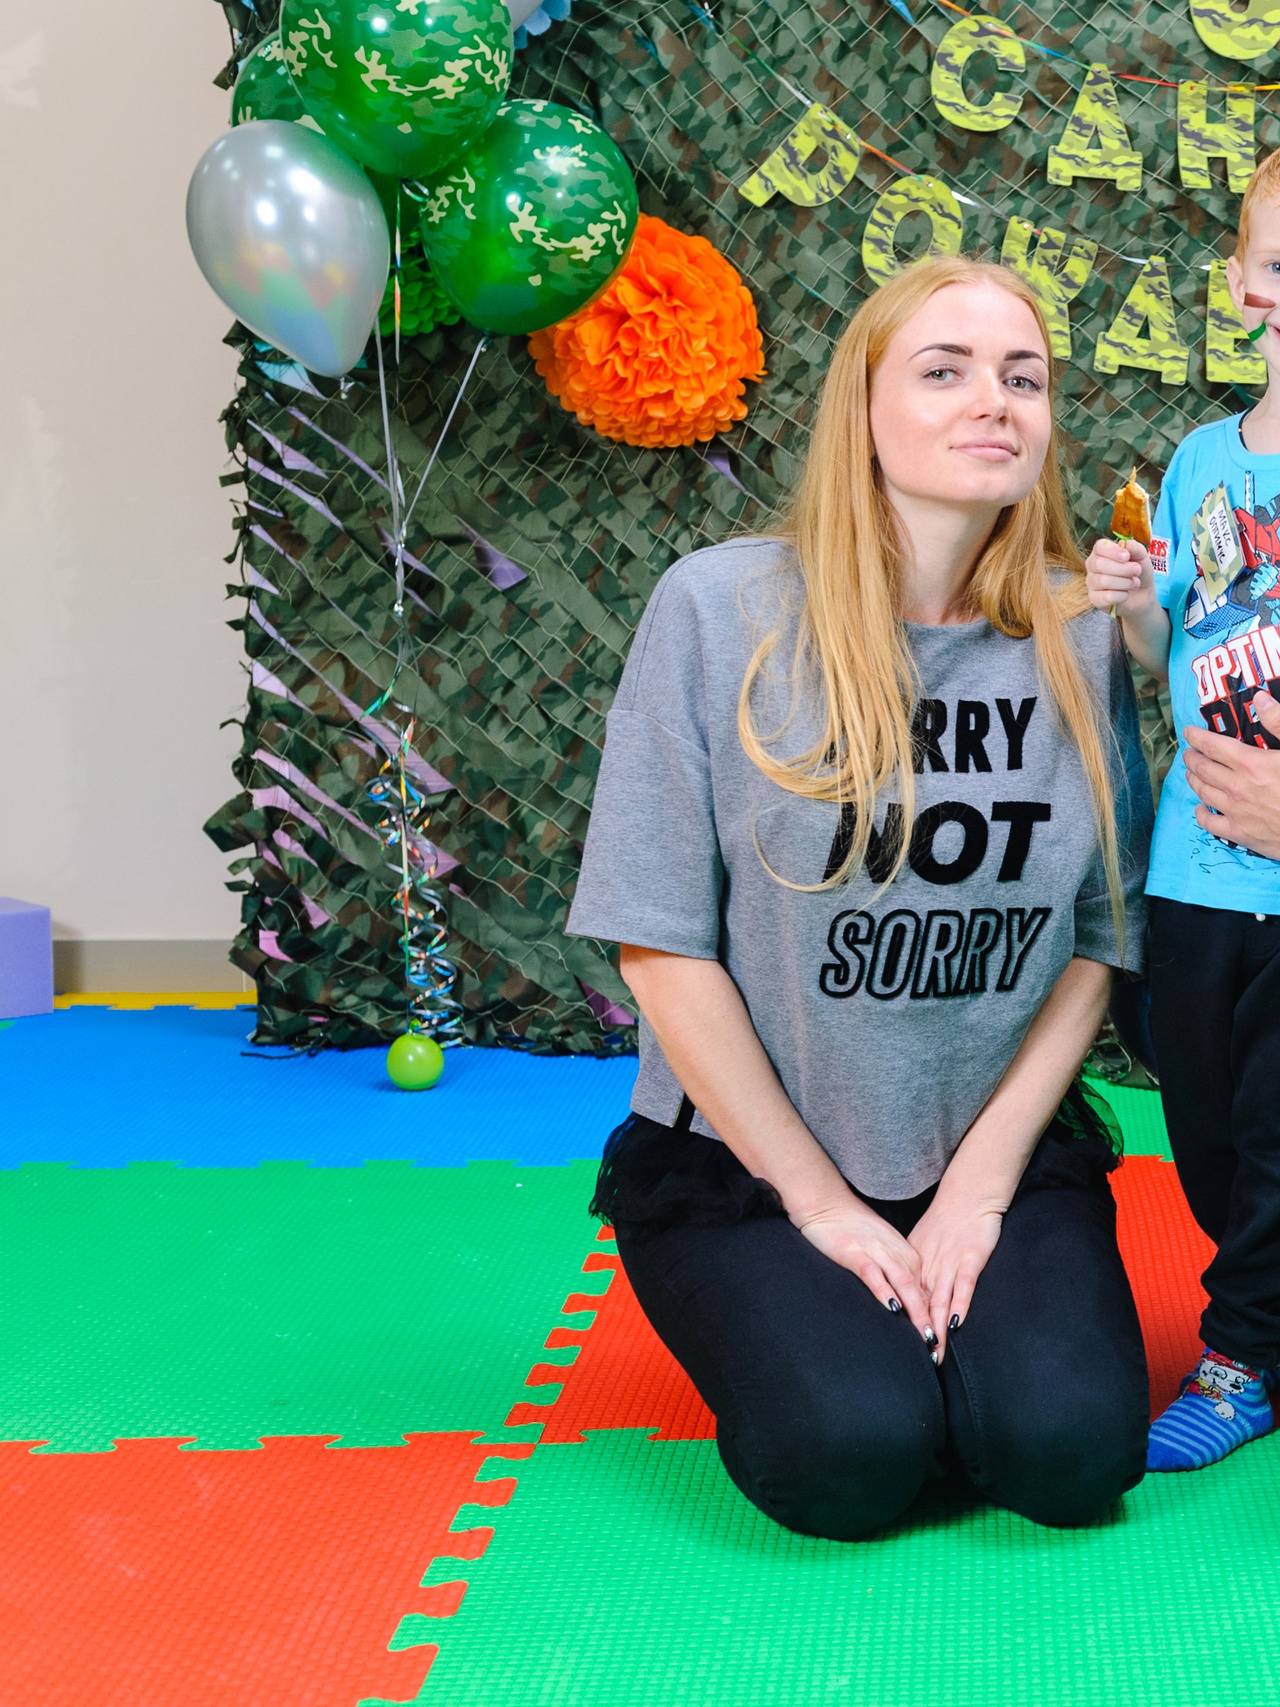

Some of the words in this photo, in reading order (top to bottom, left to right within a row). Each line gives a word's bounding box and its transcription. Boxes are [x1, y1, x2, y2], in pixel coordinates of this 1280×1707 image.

[824, 696, 1037, 774] RRY
[822, 801, 1052, 885] NOT
[819, 906, 1053, 1000] SORRY
